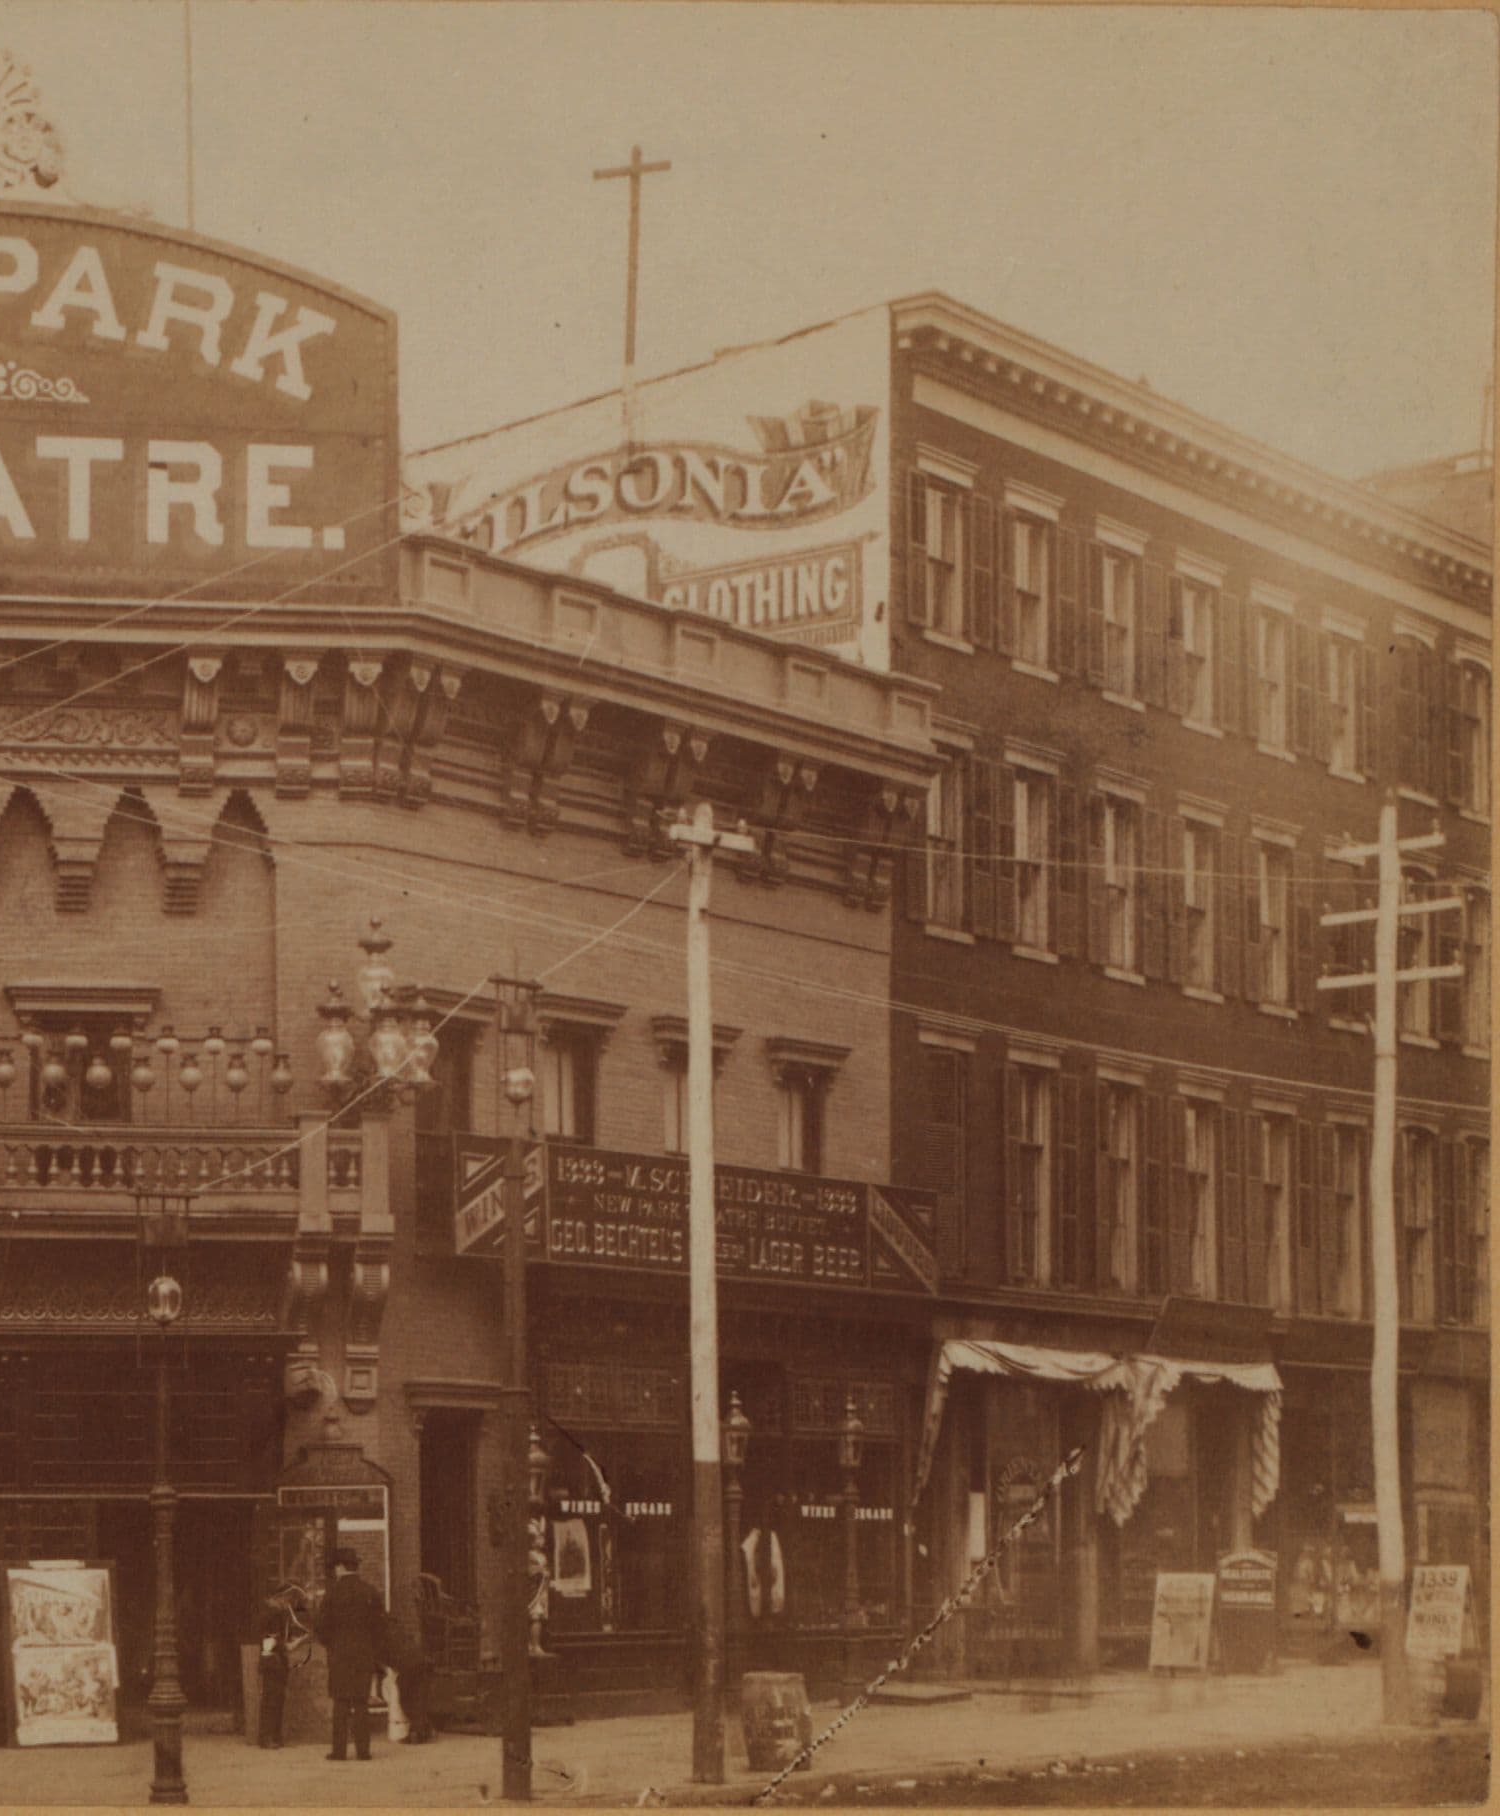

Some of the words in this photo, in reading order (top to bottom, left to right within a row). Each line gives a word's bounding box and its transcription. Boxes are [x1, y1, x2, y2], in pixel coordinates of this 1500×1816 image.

[593, 1193, 633, 1214] NEW
[638, 1198, 683, 1220] PARK
[748, 1236, 804, 1275] LAGER
[812, 1244, 865, 1281] BEER
[560, 1499, 602, 1514] WINES
[800, 1504, 837, 1519] WINES
